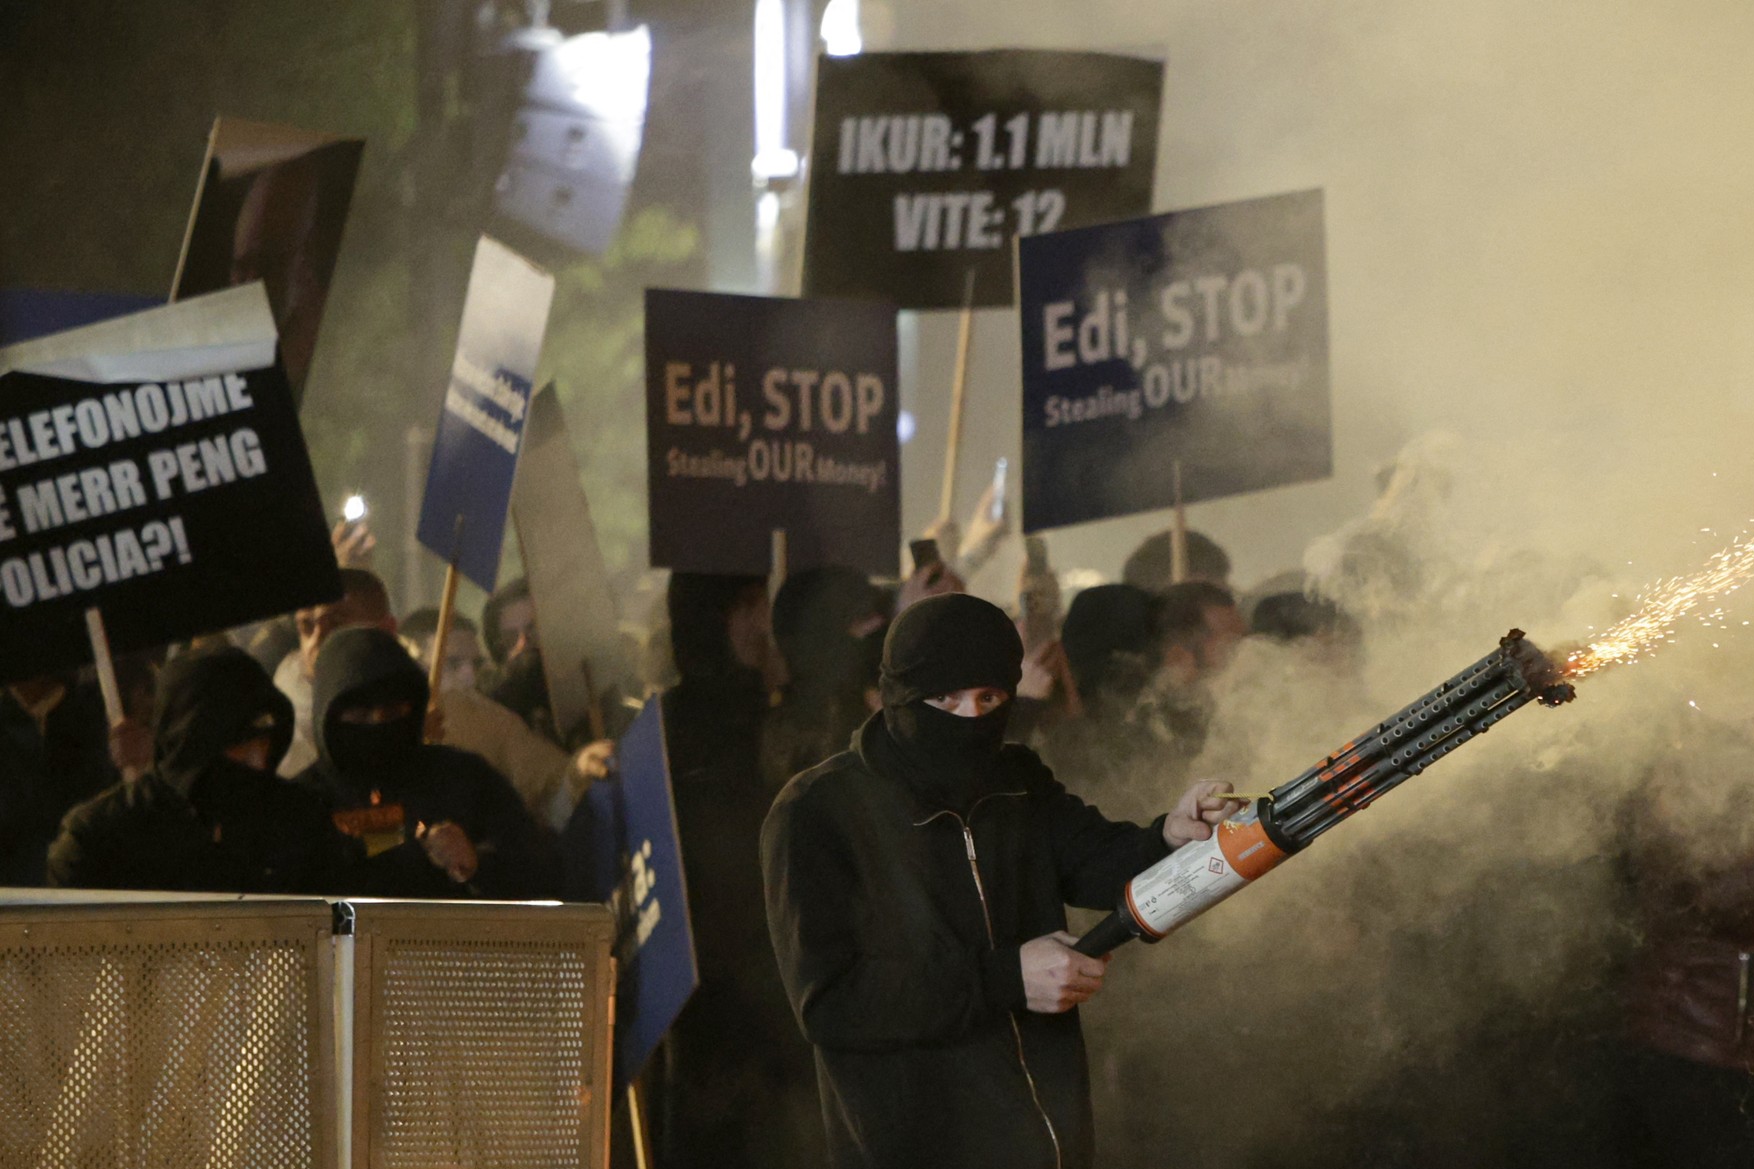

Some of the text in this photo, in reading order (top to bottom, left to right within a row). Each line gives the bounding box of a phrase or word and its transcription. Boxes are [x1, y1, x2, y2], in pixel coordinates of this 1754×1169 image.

[838, 110, 1133, 174] IKUR: 1.1 MLN
[894, 190, 1005, 250] VITE:
[1043, 263, 1304, 371] Edi, STOP
[666, 360, 884, 441] Edi, STOP
[1044, 386, 1143, 428] Stealing
[1143, 356, 1222, 408] OUR
[17, 460, 147, 533] MERR
[148, 427, 267, 500] PENG
[750, 438, 814, 482] OUR
[0, 515, 192, 607] OLICIA?!
